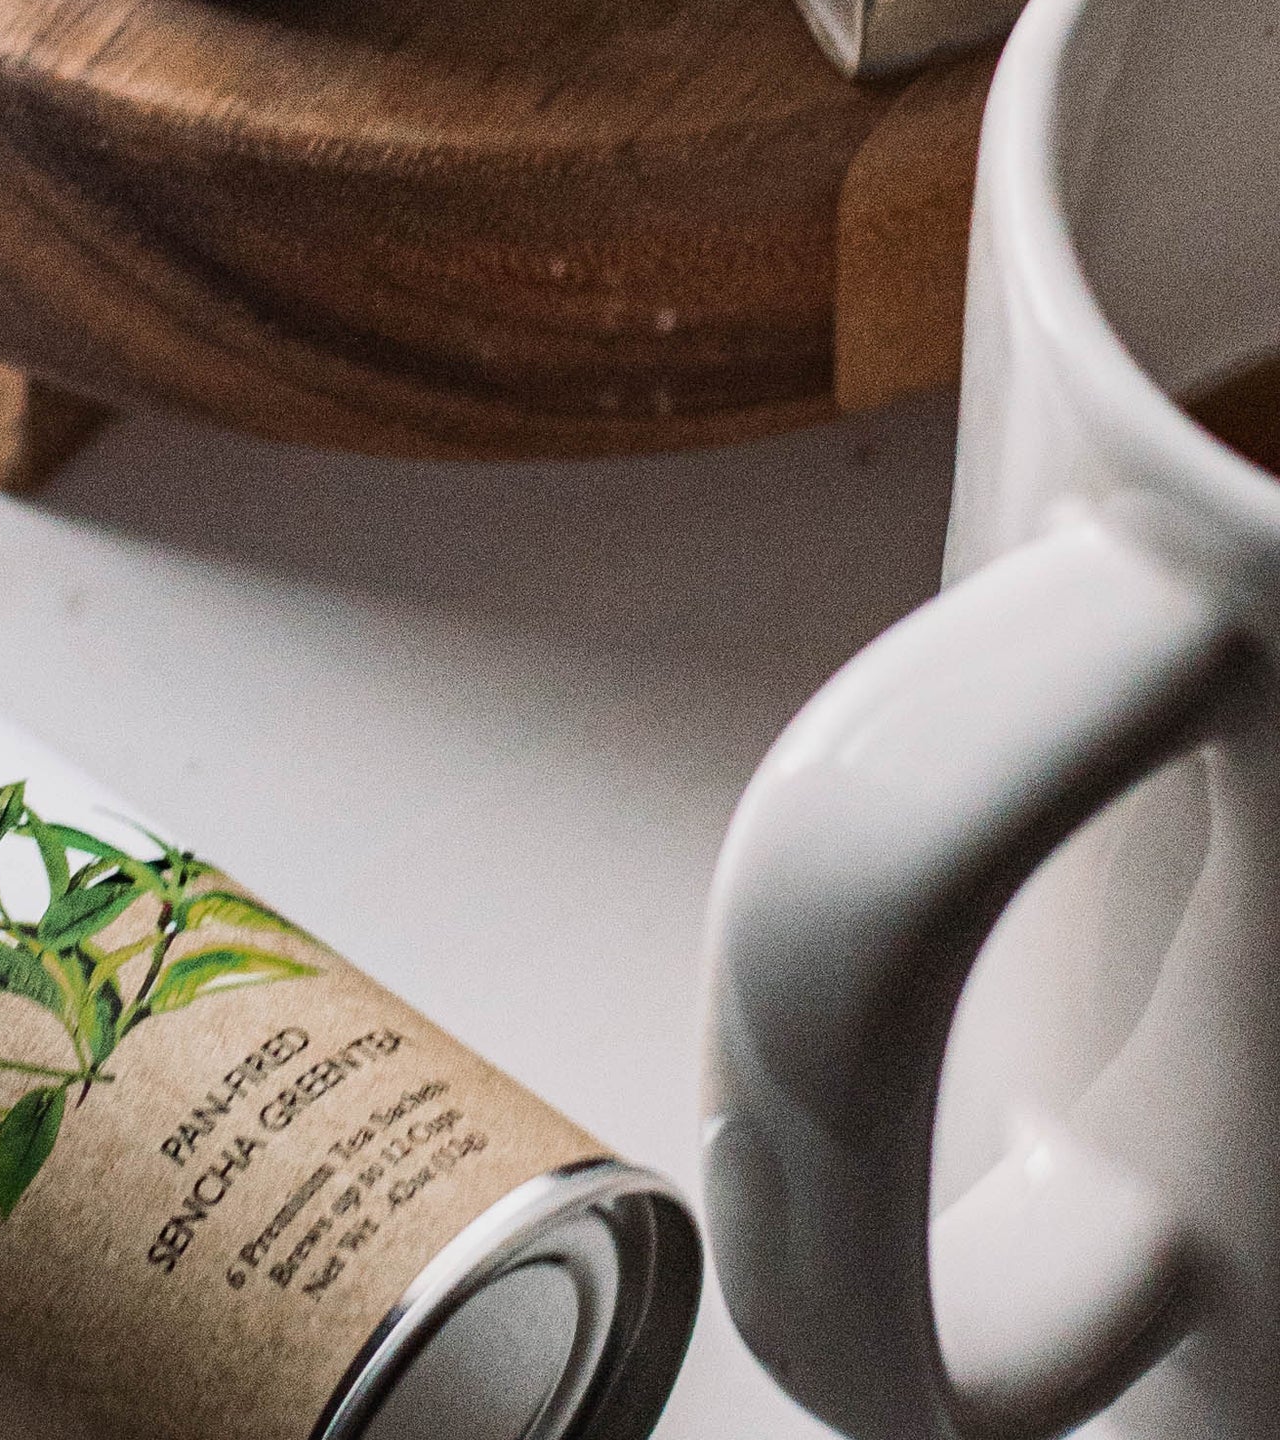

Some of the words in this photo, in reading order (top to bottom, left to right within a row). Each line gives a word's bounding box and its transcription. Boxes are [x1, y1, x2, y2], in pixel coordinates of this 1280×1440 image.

[147, 1134, 267, 1274] SENCHA
[258, 1046, 359, 1133] GREEN
[159, 1026, 310, 1168] PAN-FIRED
[239, 1163, 335, 1268] Premium
[327, 1126, 375, 1161] Tea
[269, 1215, 332, 1289] Brews
